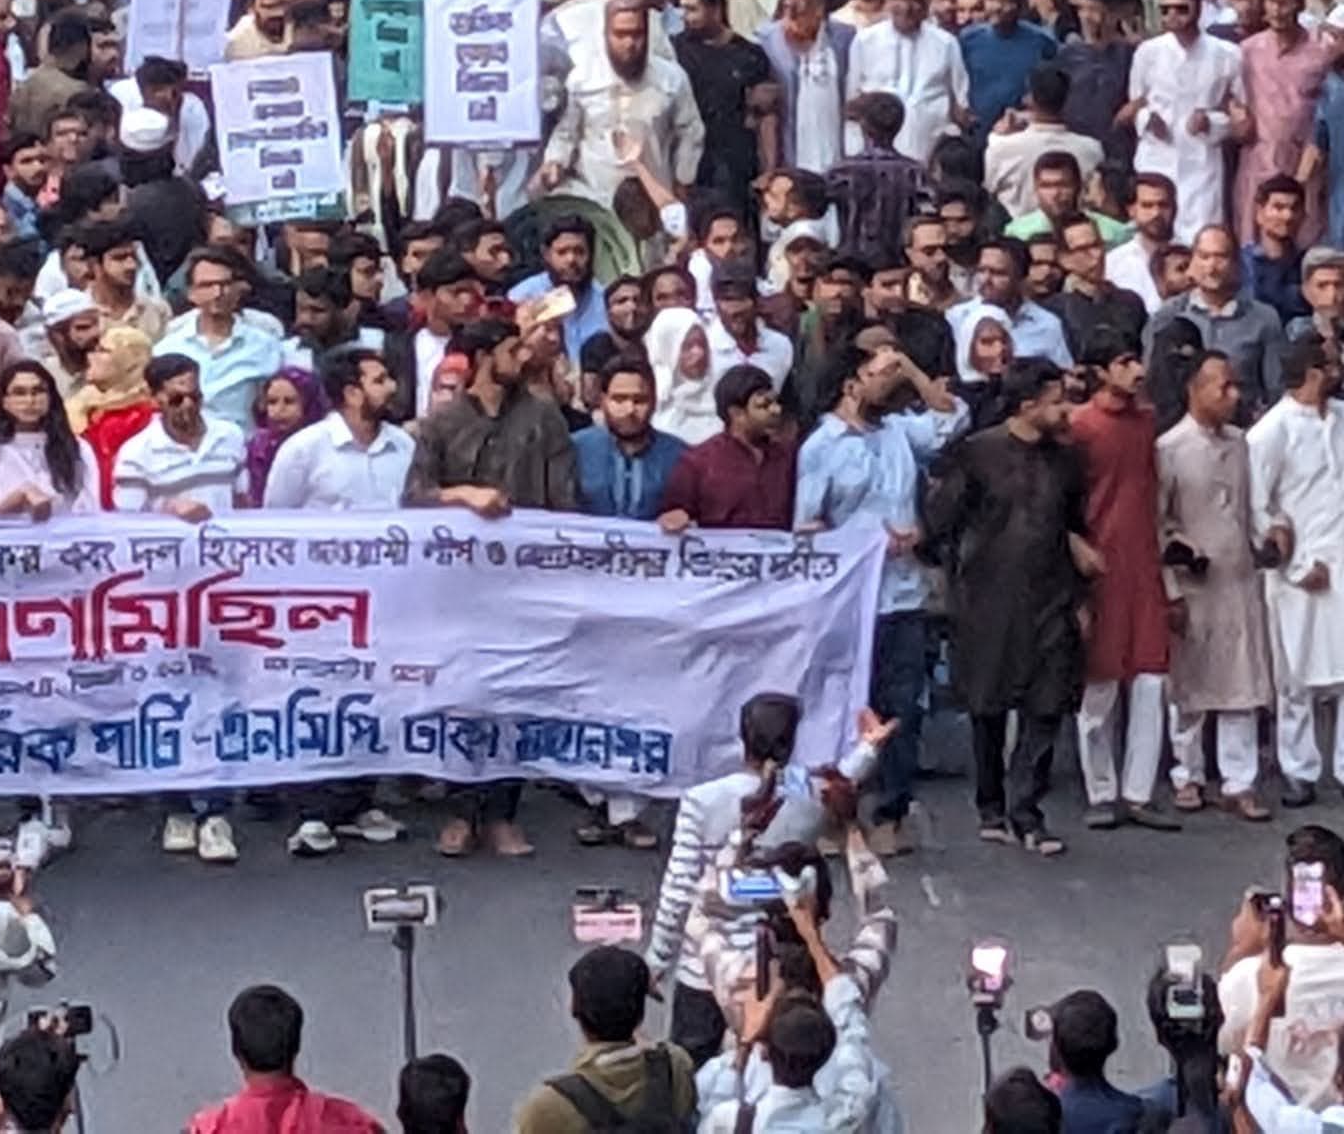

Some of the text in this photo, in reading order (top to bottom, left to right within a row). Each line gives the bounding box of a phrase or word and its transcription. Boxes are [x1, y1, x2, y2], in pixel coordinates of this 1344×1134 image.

[90, 692, 191, 769] পার্টি
[402, 711, 500, 761] ঢাকা
[515, 719, 673, 775] মহানগর
